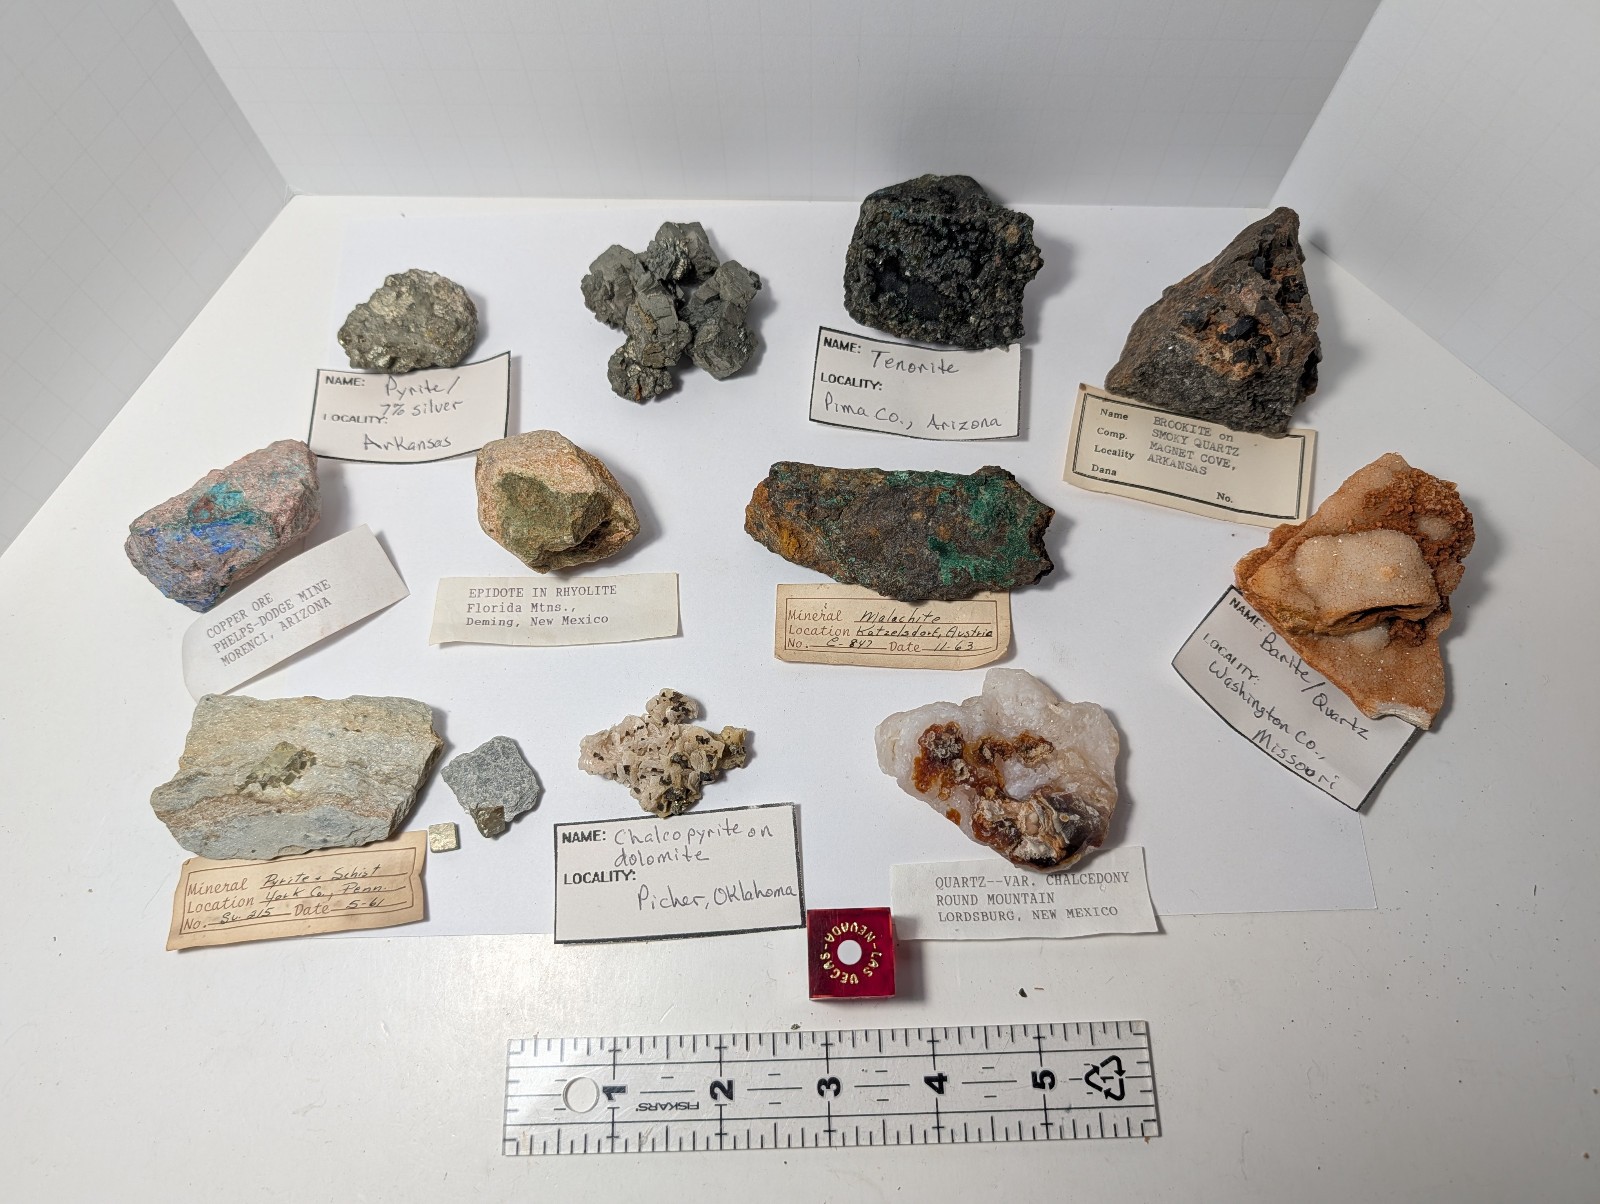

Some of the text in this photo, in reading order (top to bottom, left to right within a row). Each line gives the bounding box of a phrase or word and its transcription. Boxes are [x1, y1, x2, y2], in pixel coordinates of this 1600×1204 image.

[824, 337, 861, 353] NAME:
[871, 350, 960, 374] Tenorite
[325, 376, 365, 386] NAME:
[821, 372, 883, 390] LOCALITY:
[380, 400, 463, 416] 7% silver
[825, 392, 1002, 431] Pima Co., Arizona
[1100, 408, 1129, 420] Name
[1097, 427, 1128, 440] Comp.
[1153, 416, 1234, 442] BROOKITE on
[364, 433, 451, 451] Arkansas
[1152, 429, 1240, 457] SMOKY QUARTZ
[1094, 445, 1135, 460] Locality
[1149, 441, 1236, 471] MAGNET COVE,
[1091, 464, 1117, 476] Dana
[1147, 454, 1207, 475] ARKANSAS
[1216, 492, 1233, 503] No.
[469, 585, 617, 599] EPIDOTE IN RHYOLITE
[206, 592, 274, 639] COPPER ORE
[212, 579, 331, 653] PHELPS-DODGE MINE
[467, 603, 576, 613] Florida Mtns.,
[787, 608, 843, 621] Mineral
[859, 607, 941, 624] Malachite
[1229, 596, 1267, 632] NAME:
[466, 615, 609, 628] Deming, New Mexico
[220, 597, 332, 666] MORENCI, ARIZONA
[788, 625, 850, 636] Location
[945, 626, 993, 639] Austria
[787, 638, 809, 649] No.
[889, 642, 922, 653] Date
[1202, 632, 1260, 685] LOCALITY:
[1208, 661, 1326, 760] Washington Co.,
[562, 830, 607, 844] NAME:
[747, 825, 774, 838] on
[614, 845, 710, 868] dolomite
[262, 873, 310, 889] Pyrite
[331, 864, 381, 881] Schist
[564, 869, 637, 885] LOCALITY:
[1045, 871, 1130, 887] CHALCEDONY
[188, 878, 248, 896] Mineral
[637, 880, 797, 911] Picher, Oklahoma
[937, 892, 1055, 906] ROUND MOUNTAIN
[187, 896, 255, 914] Location
[293, 904, 331, 917] Date
[938, 907, 1118, 922] LORDSBURG, NEW MEXICO
[183, 917, 207, 930] No.
[817, 1076, 843, 1097] 3
[924, 1073, 947, 1094] 4
[1031, 1069, 1056, 1090] 5
[603, 1086, 626, 1100] 1
[709, 1080, 734, 1101] 2
